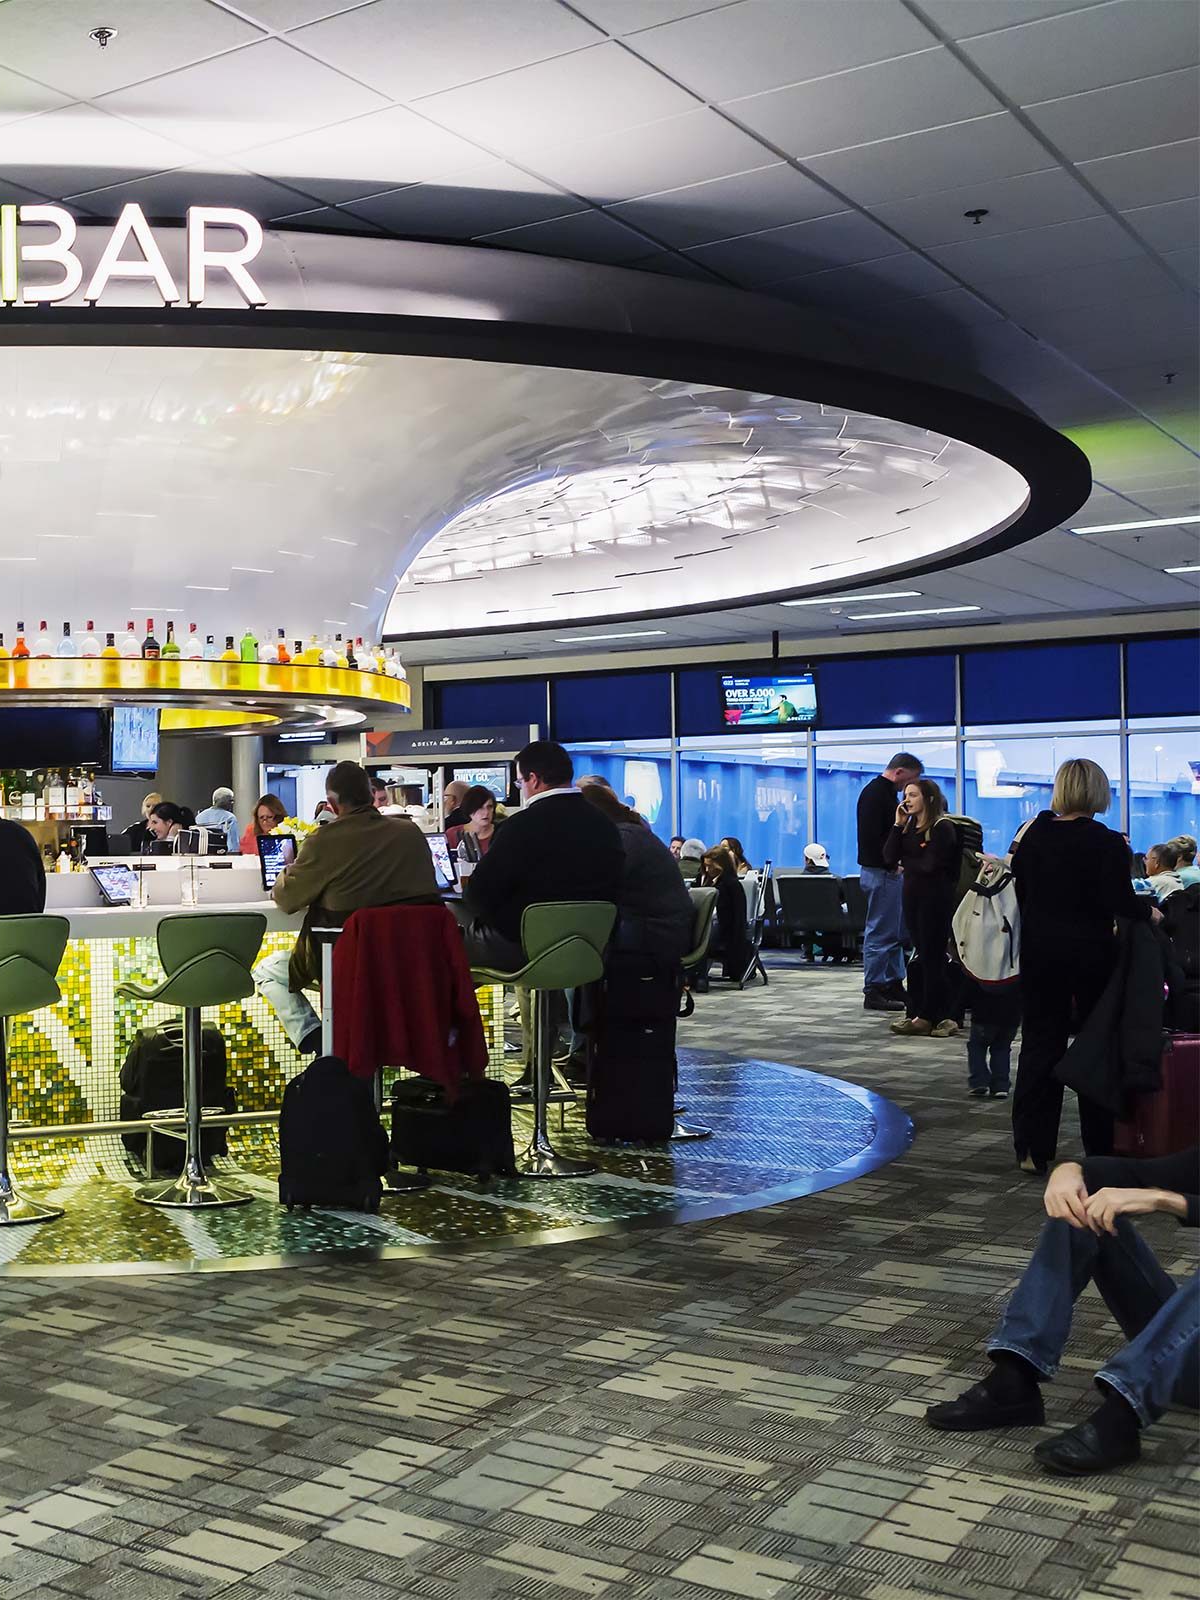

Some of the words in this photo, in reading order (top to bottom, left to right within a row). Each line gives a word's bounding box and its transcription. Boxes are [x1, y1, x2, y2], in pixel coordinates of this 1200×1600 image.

[725, 689, 748, 697] OVER
[749, 688, 775, 697] 5,000
[454, 773, 474, 782] ONLY
